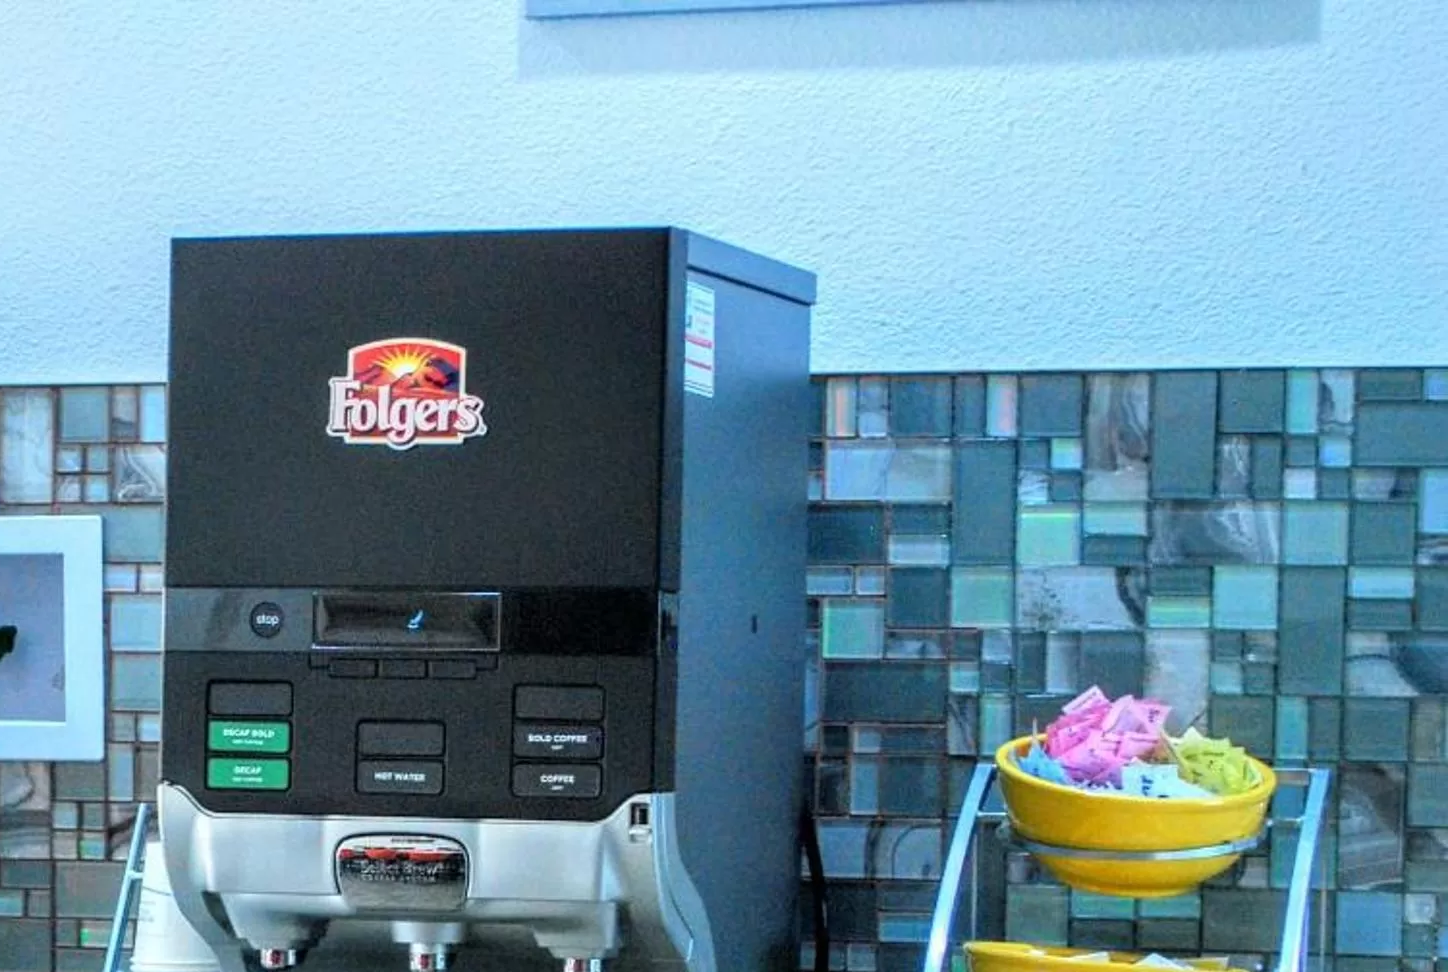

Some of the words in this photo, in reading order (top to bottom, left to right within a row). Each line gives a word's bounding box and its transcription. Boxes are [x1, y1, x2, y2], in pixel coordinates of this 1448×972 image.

[329, 380, 482, 444] Folgers
[255, 612, 280, 627] stop
[553, 734, 587, 743] COFFEE
[394, 773, 426, 782] WATER
[539, 774, 574, 783] COFFEE
